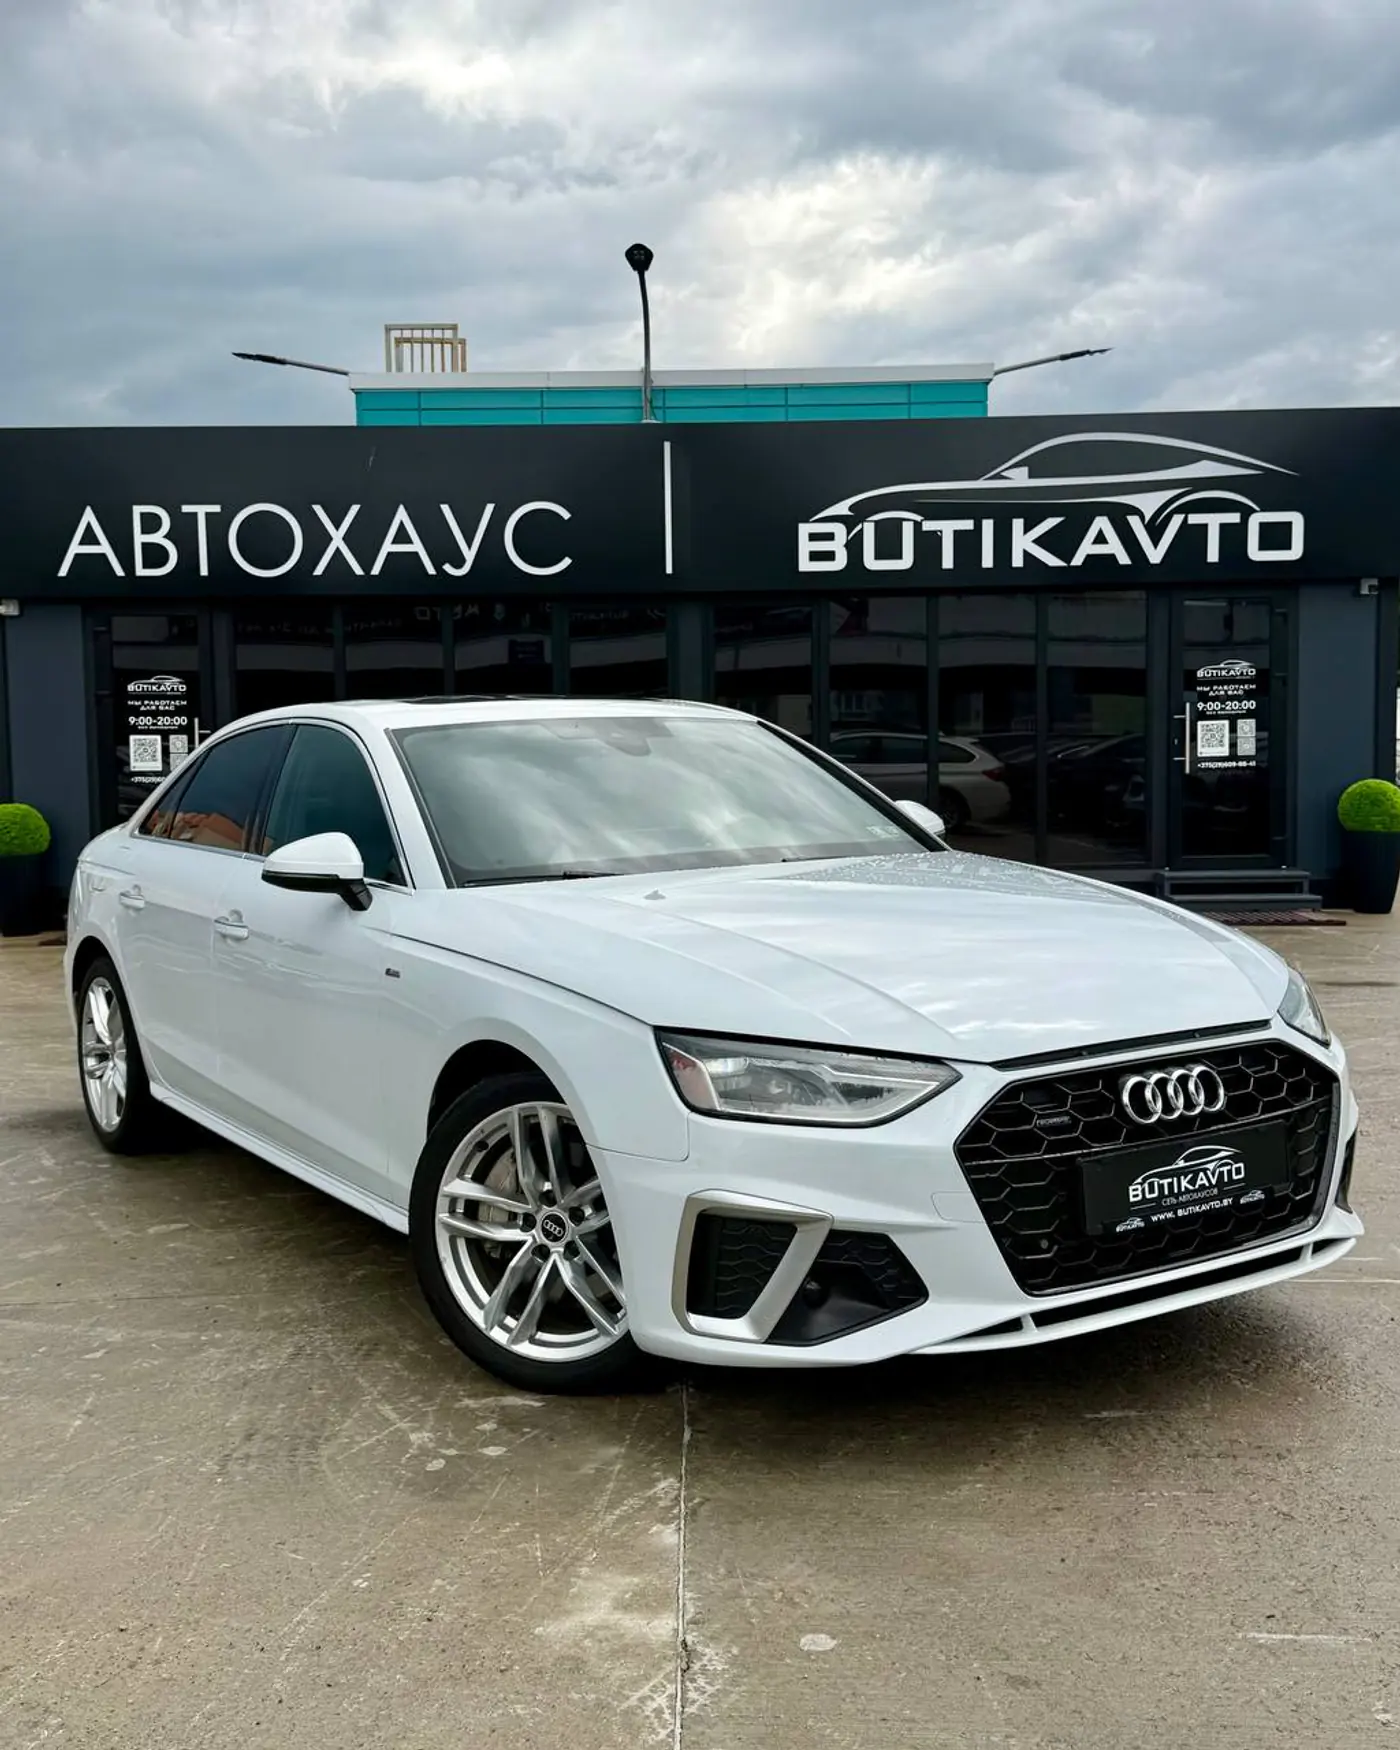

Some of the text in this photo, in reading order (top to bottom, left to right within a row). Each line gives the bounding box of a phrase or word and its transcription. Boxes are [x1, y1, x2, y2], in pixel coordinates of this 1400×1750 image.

[57, 501, 573, 578] АВТОХАУС
[797, 511, 1305, 573] BUTIKAVTO
[1197, 668, 1256, 678] BUTIKAVTO
[128, 684, 187, 692] BUTIKAVTO
[1197, 700, 1256, 711] 9:00-20:00
[128, 716, 188, 725] 9:00-20:00
[1128, 1162, 1245, 1202] BUTIKAVTO
